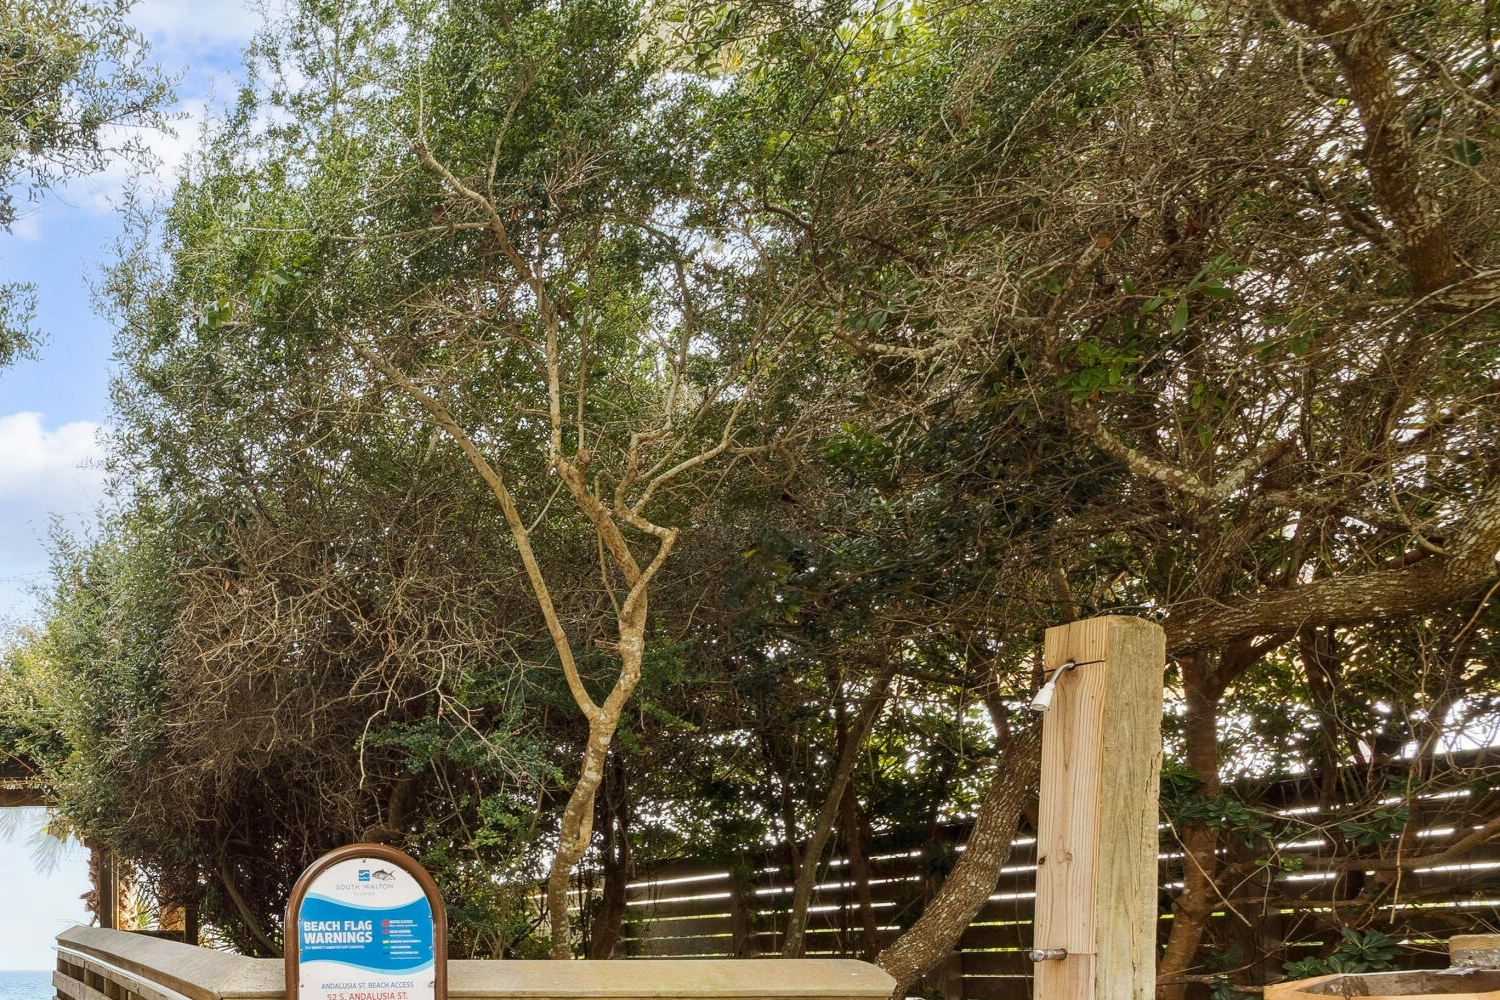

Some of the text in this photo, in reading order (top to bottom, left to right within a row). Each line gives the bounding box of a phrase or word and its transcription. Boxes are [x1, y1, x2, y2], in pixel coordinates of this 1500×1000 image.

[304, 920, 372, 931] BEACH FLAG
[304, 932, 372, 944] WARNINGS
[339, 993, 346, 1000] S.
[349, 992, 395, 1000] ANDALUSIA
[398, 992, 408, 1000] ST.
